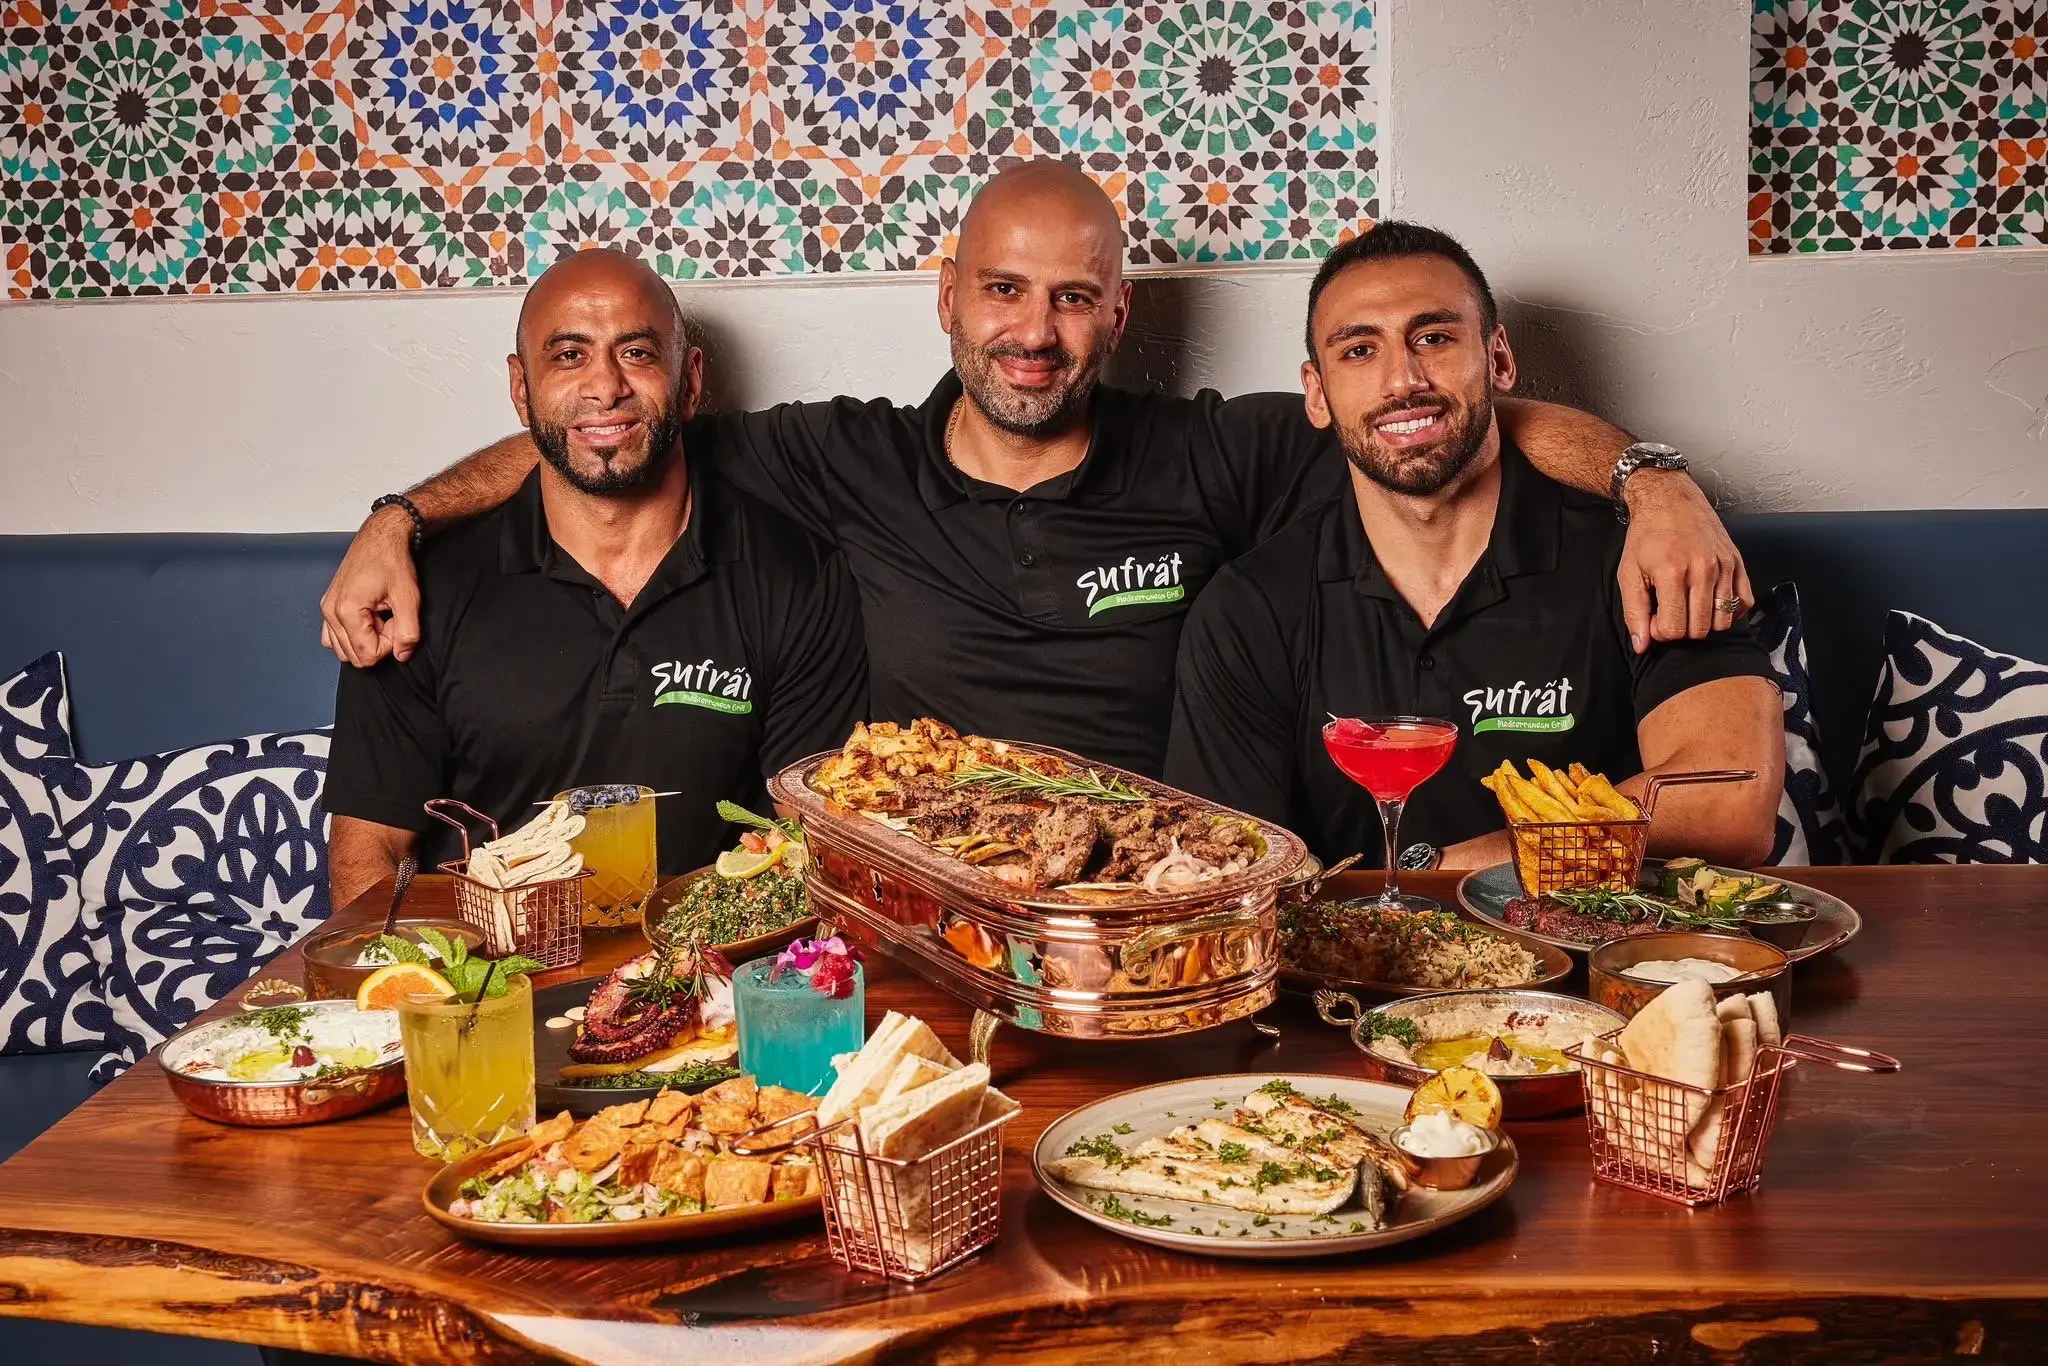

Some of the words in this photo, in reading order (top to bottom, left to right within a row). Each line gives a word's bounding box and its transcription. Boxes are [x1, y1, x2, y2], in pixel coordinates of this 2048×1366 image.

[1166, 590, 1179, 600] Grill
[1497, 719, 1550, 730] Mediterranean
[1551, 720, 1568, 729] Grill
